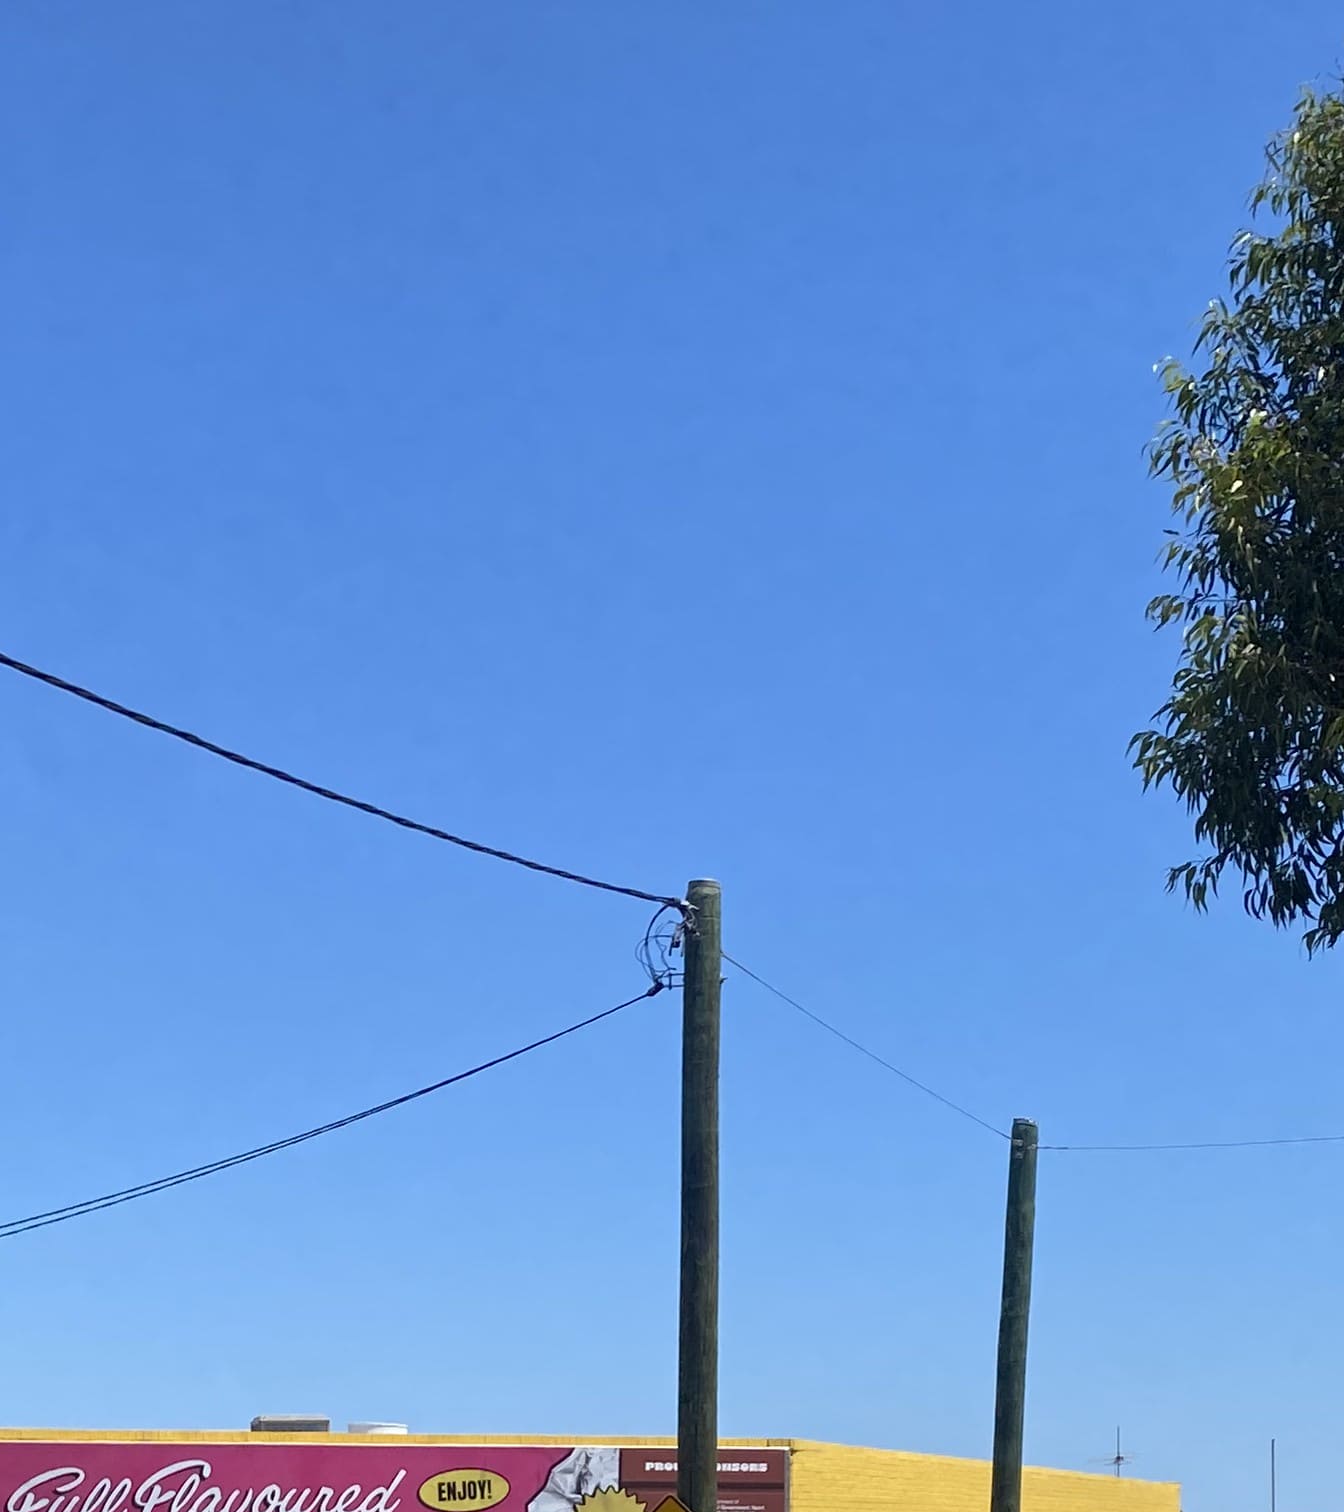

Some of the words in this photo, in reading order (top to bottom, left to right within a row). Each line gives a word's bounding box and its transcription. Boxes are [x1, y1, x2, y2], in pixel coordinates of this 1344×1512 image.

[645, 1462, 679, 1471] PRO
[716, 1462, 768, 1472] NSORS
[438, 1479, 492, 1502] ENJOY!
